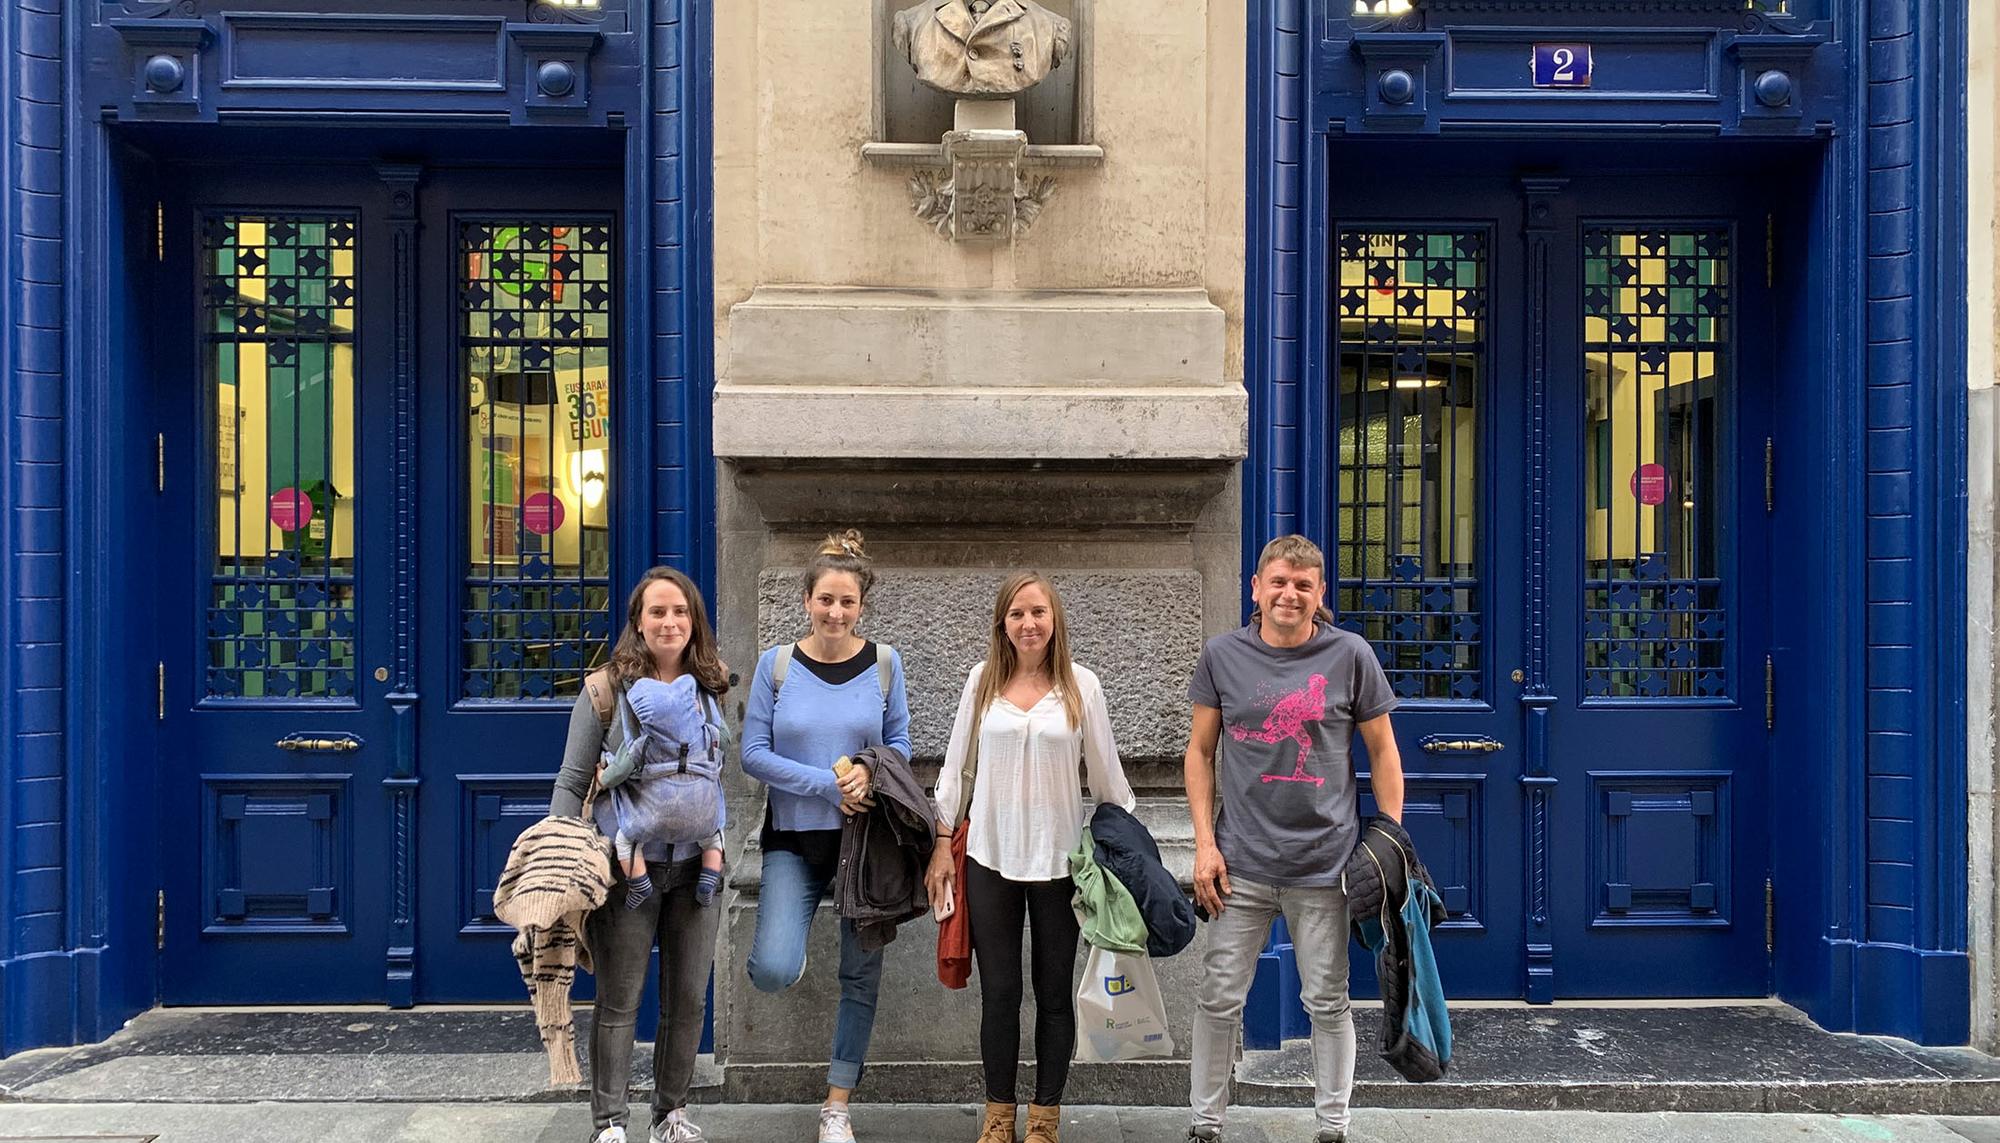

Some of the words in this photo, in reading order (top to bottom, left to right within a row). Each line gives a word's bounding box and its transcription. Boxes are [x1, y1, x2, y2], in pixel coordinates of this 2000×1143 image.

[1553, 48, 1574, 80] 2
[567, 391, 609, 420] 365
[1106, 1018, 1116, 1029] R
